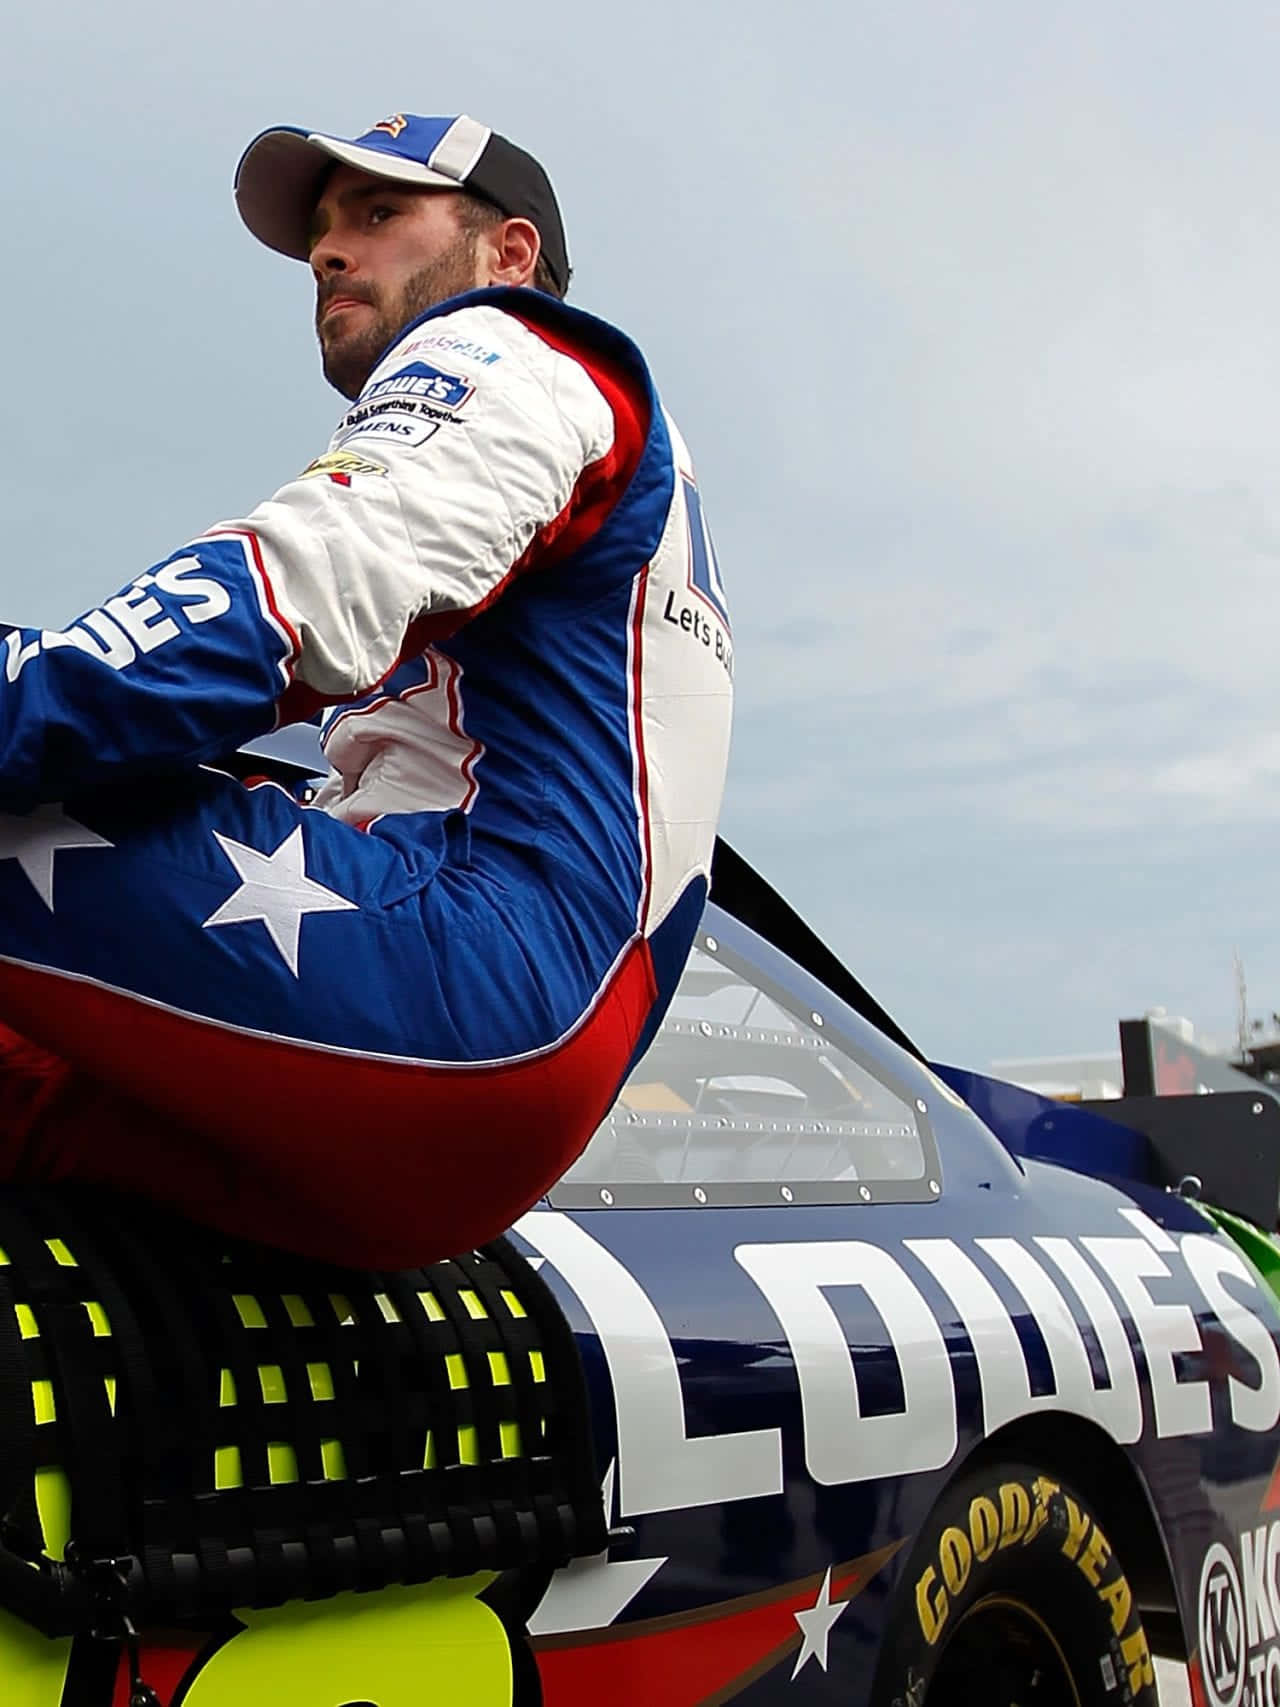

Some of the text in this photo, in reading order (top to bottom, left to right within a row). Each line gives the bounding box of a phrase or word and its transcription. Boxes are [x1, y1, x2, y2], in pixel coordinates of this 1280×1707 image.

[420, 403, 467, 425] Together
[663, 590, 711, 646] Let's
[512, 1207, 1280, 1517] LOWE'S
